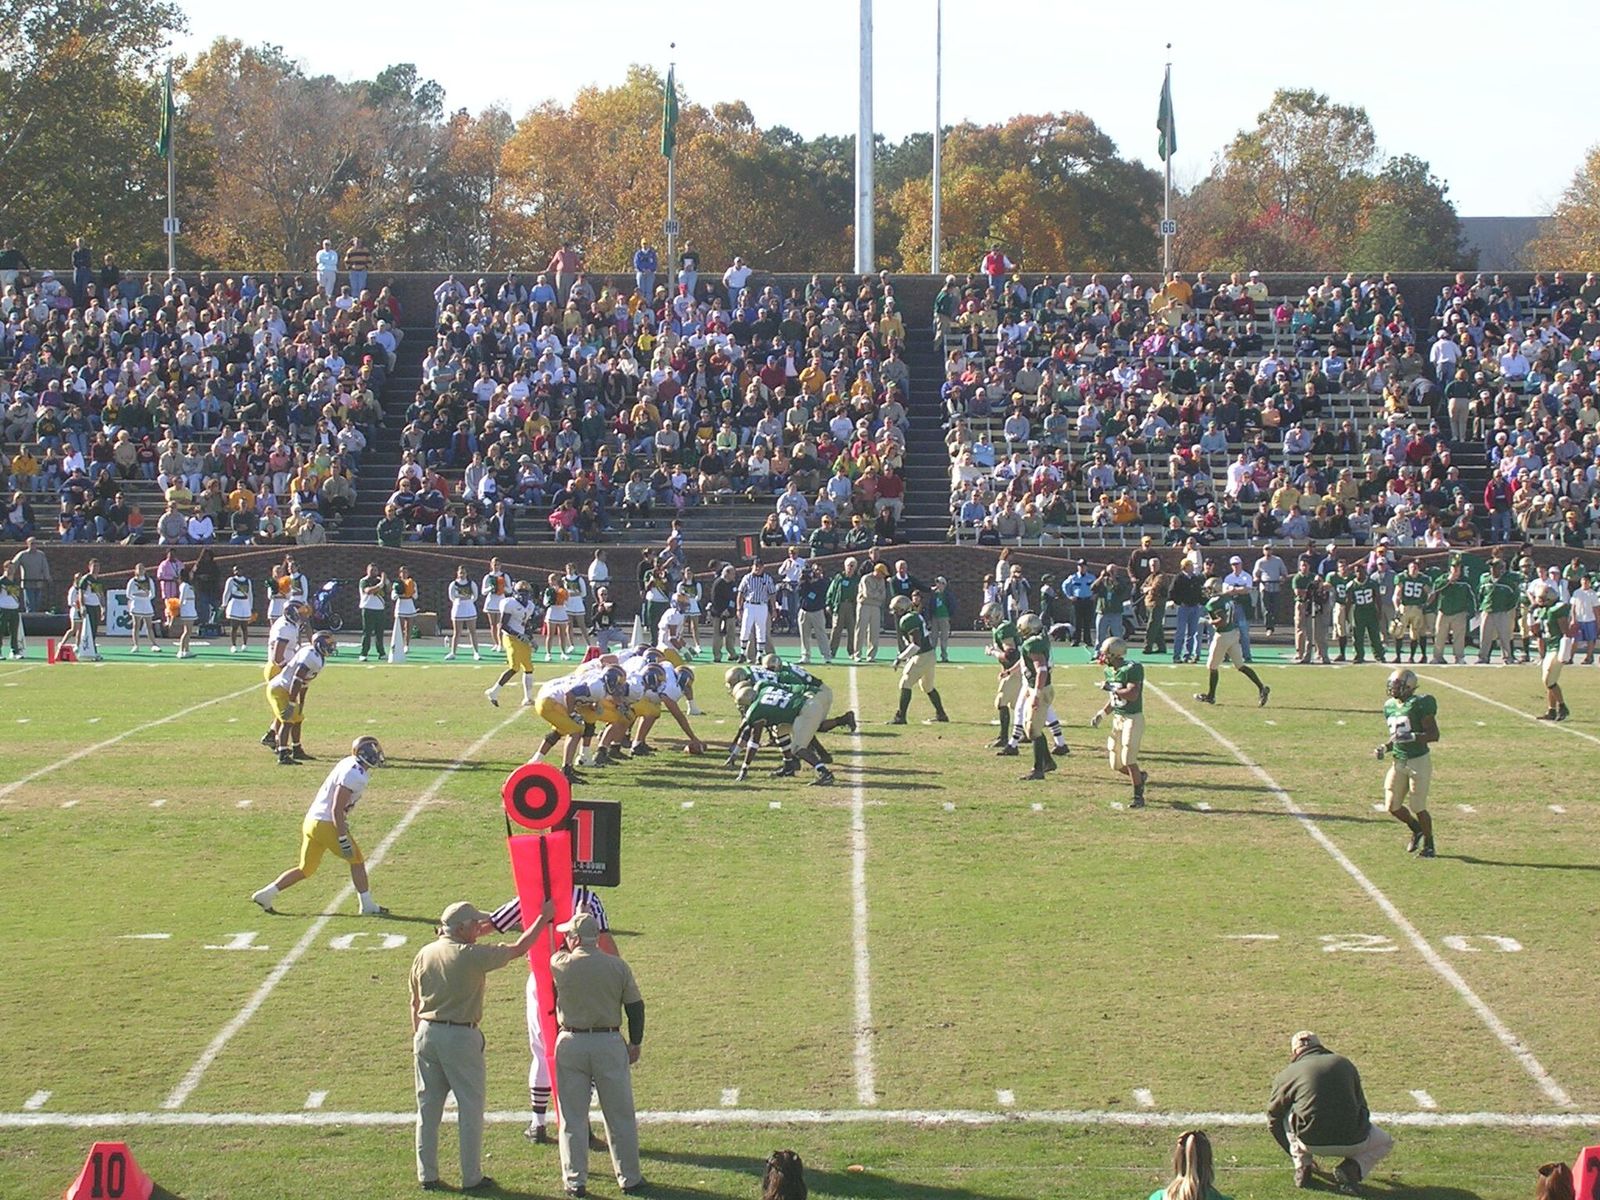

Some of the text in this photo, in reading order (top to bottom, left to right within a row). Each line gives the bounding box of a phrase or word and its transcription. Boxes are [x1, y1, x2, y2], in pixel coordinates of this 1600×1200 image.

[665, 221, 678, 233] HH
[742, 536, 753, 557] 1
[1354, 588, 1373, 605] 52
[1404, 581, 1423, 598] 55
[571, 809, 594, 862] 1
[91, 1152, 126, 1198] 10
